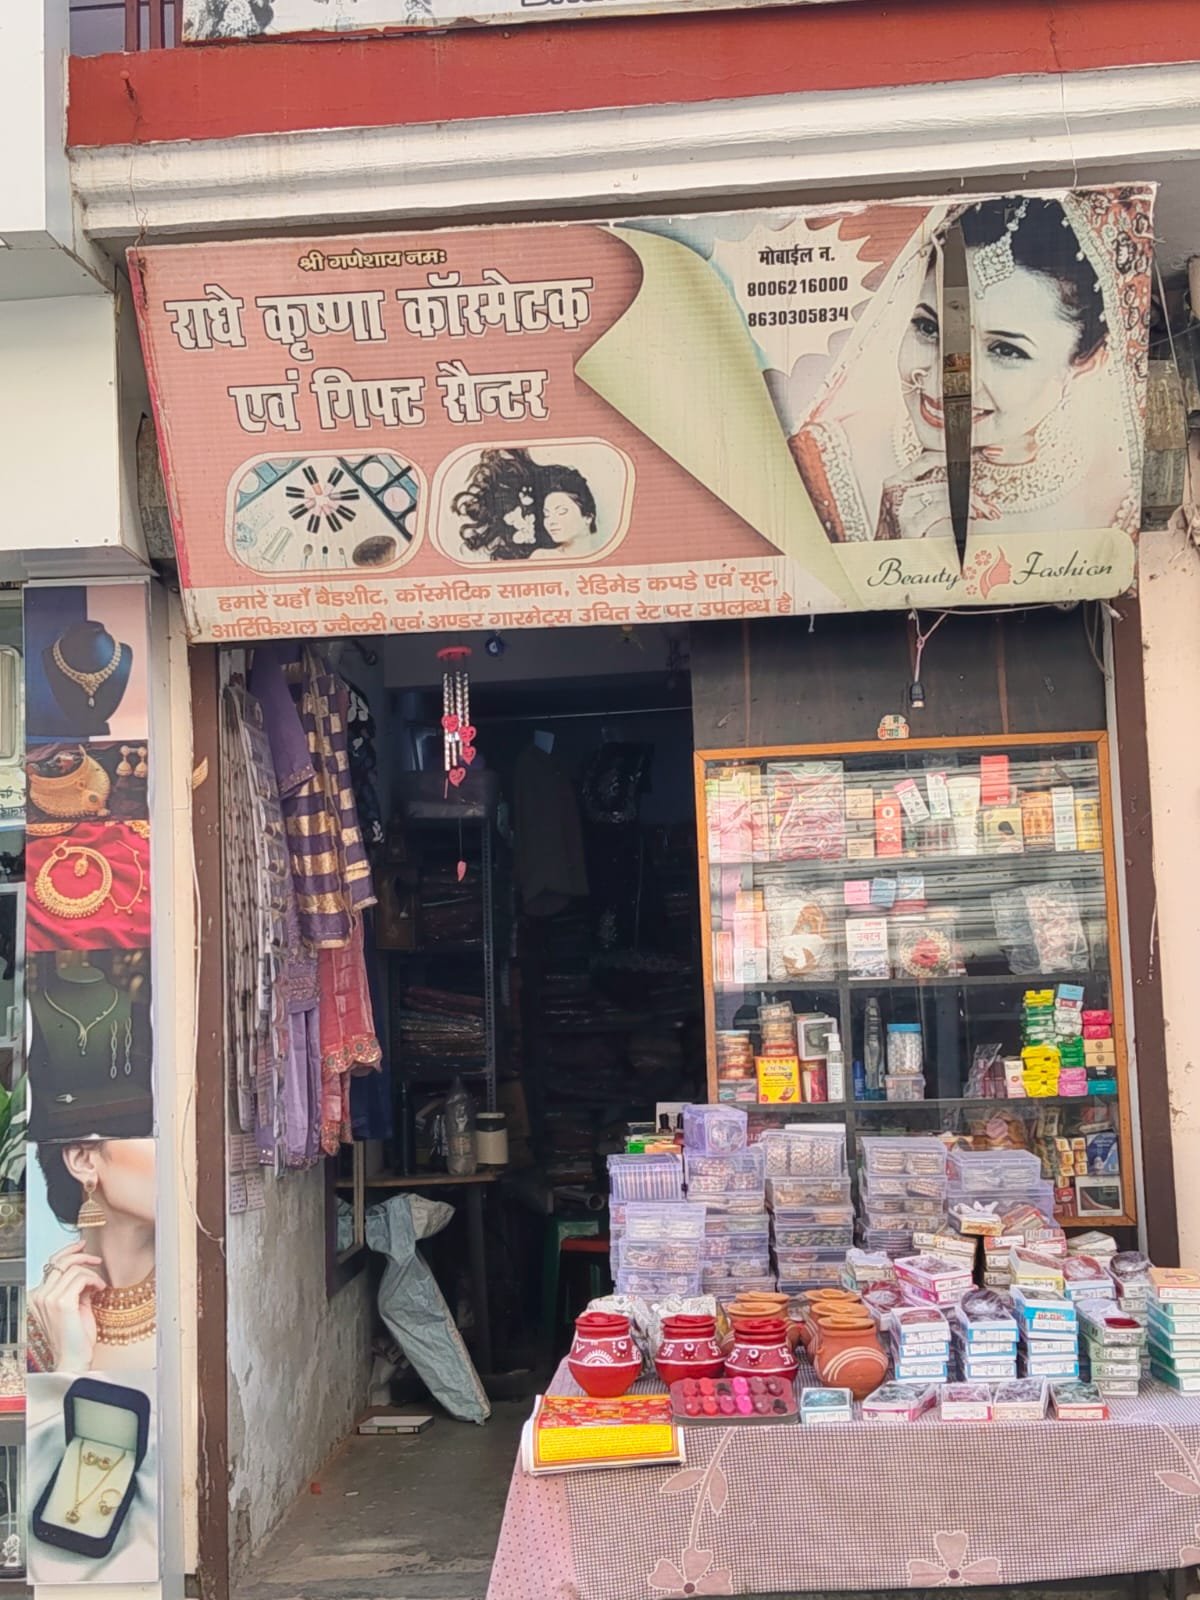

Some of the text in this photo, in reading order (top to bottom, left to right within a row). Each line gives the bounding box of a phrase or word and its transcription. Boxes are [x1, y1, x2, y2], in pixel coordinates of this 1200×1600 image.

[299, 248, 448, 272] श्री गणेशाय नमः
[758, 244, 814, 266] मोबाईल
[747, 276, 849, 297] 8006216000
[163, 283, 248, 350] राधे
[255, 289, 387, 361] कृष्णा
[747, 306, 849, 328] 8630305834
[227, 359, 549, 433] एवं गिफ्ट सैन्टर
[867, 557, 961, 590] Beauty
[1012, 550, 1113, 585] Fashion
[217, 589, 270, 612] हमारे
[394, 580, 492, 603] कॉस्मेटिक
[497, 581, 570, 599] सामान,
[576, 573, 641, 596] रेडिमेड
[647, 569, 699, 591] कपडे
[704, 566, 737, 589] एवं
[739, 570, 778, 594] सूट,
[322, 611, 387, 633] ज्वैलरी
[391, 611, 424, 631] एवं
[427, 612, 484, 630] अण्डर
[577, 601, 631, 622] उचित
[635, 599, 662, 620] रेट
[664, 603, 693, 618] पर
[698, 598, 772, 617] उपलब्ध
